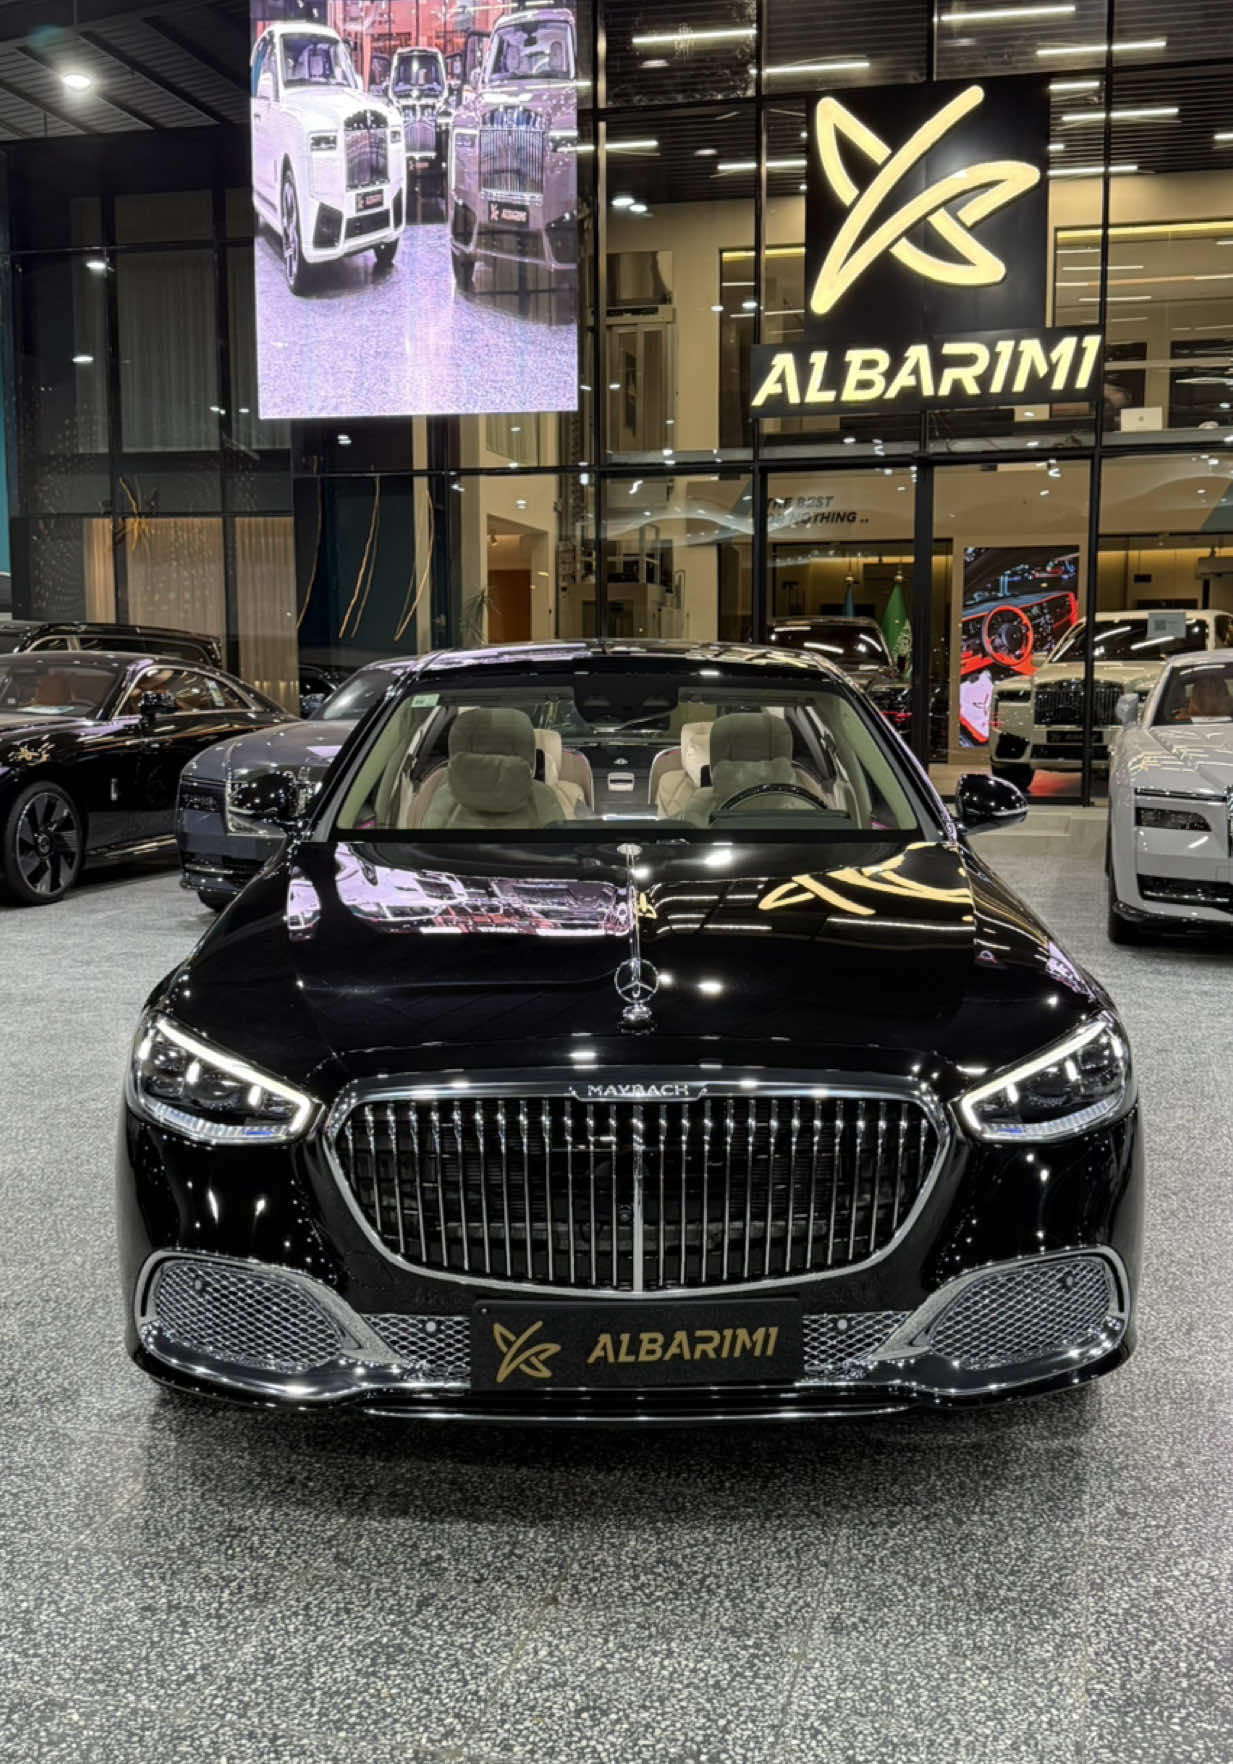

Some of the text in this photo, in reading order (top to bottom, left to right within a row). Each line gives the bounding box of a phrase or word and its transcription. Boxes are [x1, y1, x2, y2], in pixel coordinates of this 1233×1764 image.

[751, 335, 1102, 407] ALBARIMI
[587, 1084, 689, 1096] MAYBACH
[586, 1327, 779, 1364] ALBARIMI
